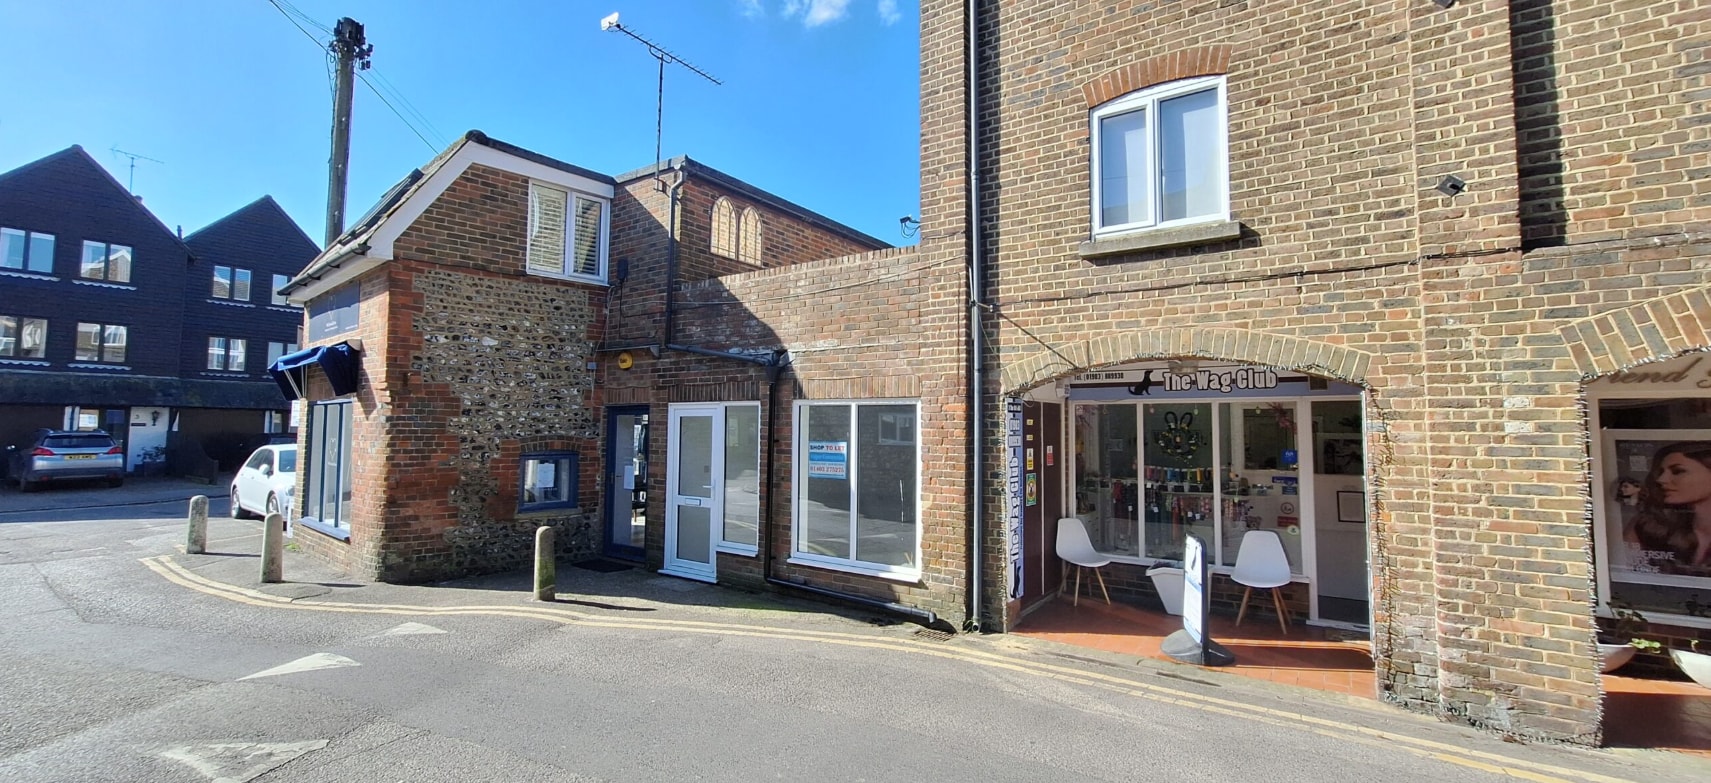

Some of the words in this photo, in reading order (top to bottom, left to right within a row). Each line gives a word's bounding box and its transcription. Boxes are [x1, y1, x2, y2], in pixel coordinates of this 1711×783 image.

[1163, 372, 1193, 392] The
[1195, 370, 1232, 393] Wag
[1236, 368, 1278, 389] Club
[1009, 456, 1020, 494] Club
[1009, 496, 1020, 532] Wag
[1009, 533, 1020, 564] The
